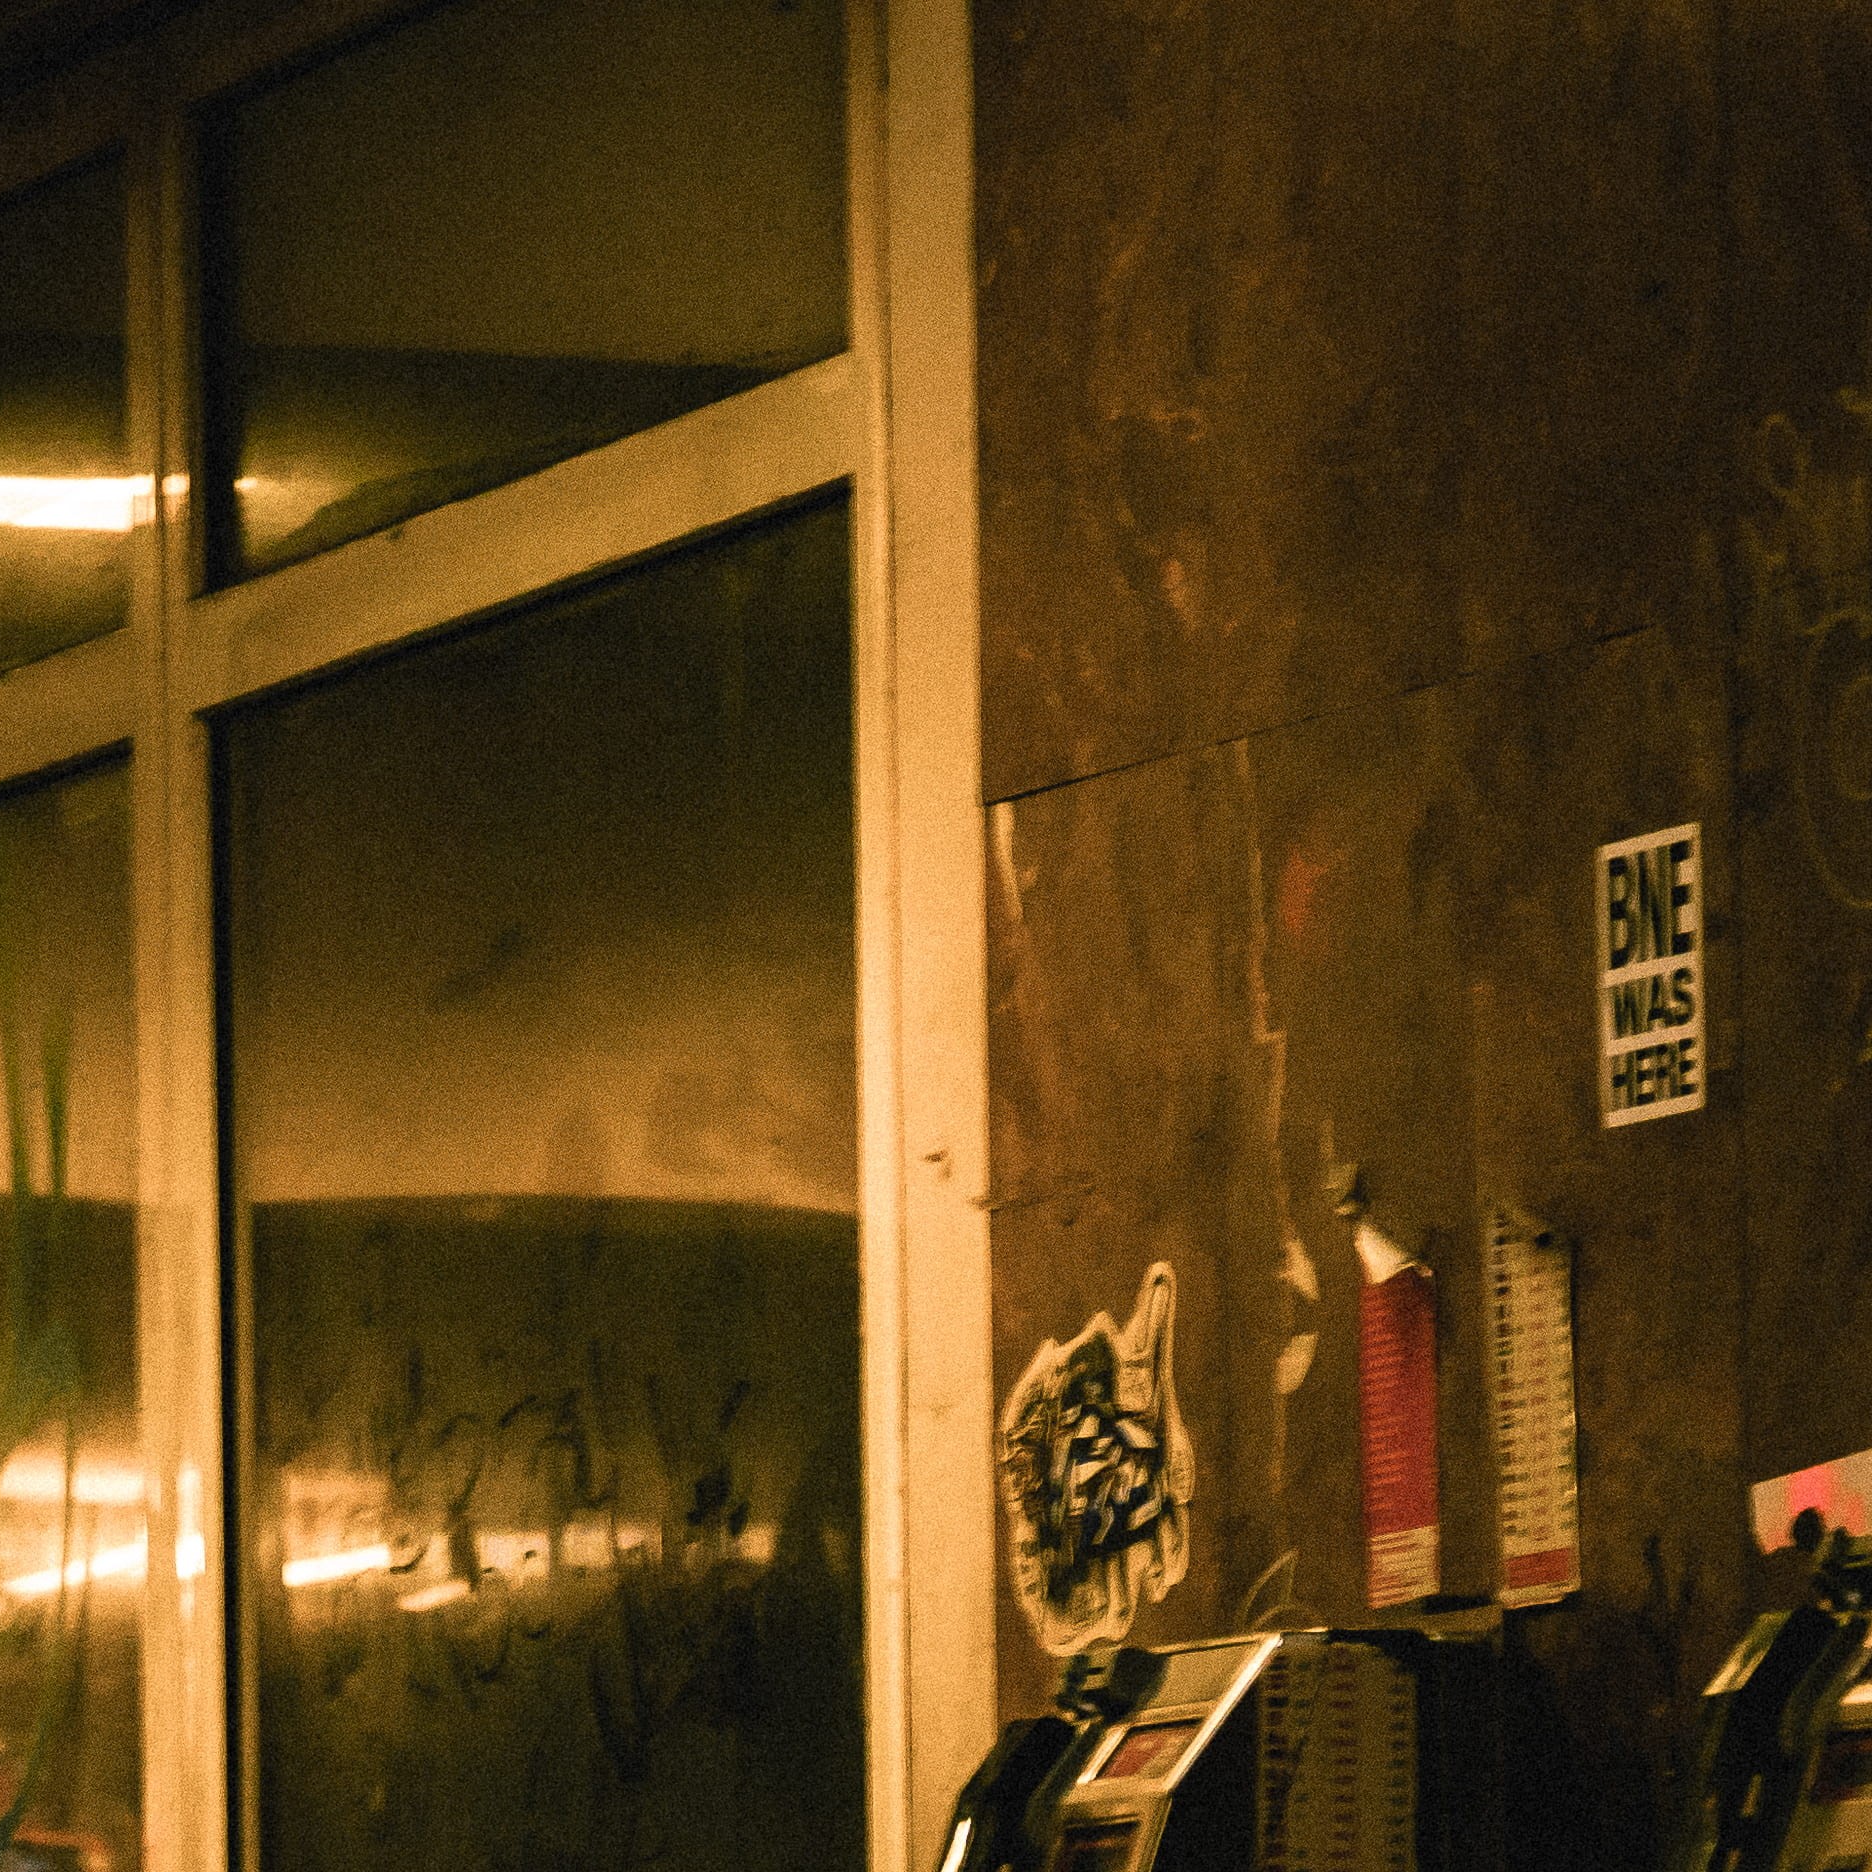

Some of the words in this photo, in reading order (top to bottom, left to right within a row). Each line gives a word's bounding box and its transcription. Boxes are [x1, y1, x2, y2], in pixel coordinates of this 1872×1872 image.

[1609, 840, 1692, 970] BNE
[1613, 967, 1693, 1039] WAS
[1612, 1038, 1695, 1111] HERE
